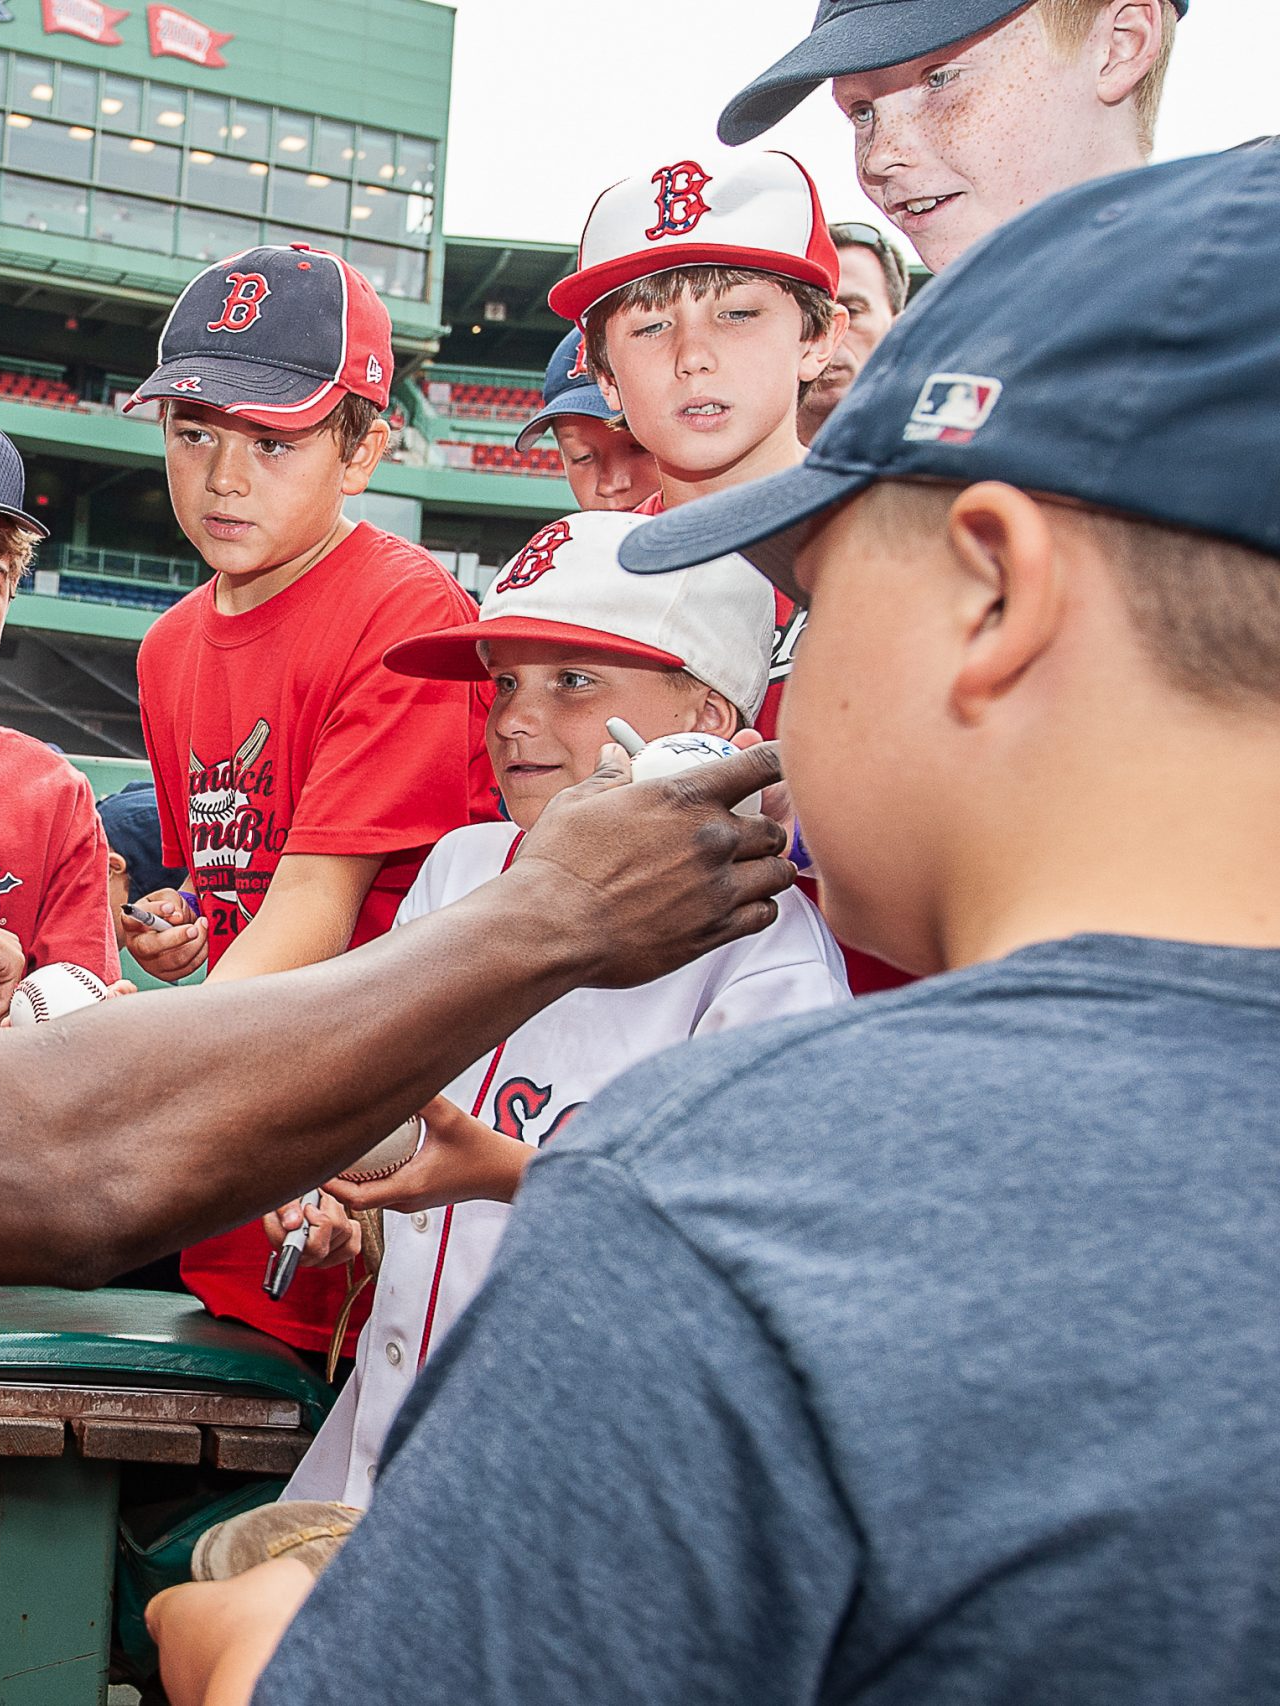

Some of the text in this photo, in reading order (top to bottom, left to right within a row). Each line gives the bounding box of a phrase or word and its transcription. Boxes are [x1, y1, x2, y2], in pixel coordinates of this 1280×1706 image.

[645, 160, 713, 241] B
[206, 272, 272, 333] B
[496, 520, 573, 594] B
[493, 1076, 588, 1149] S
